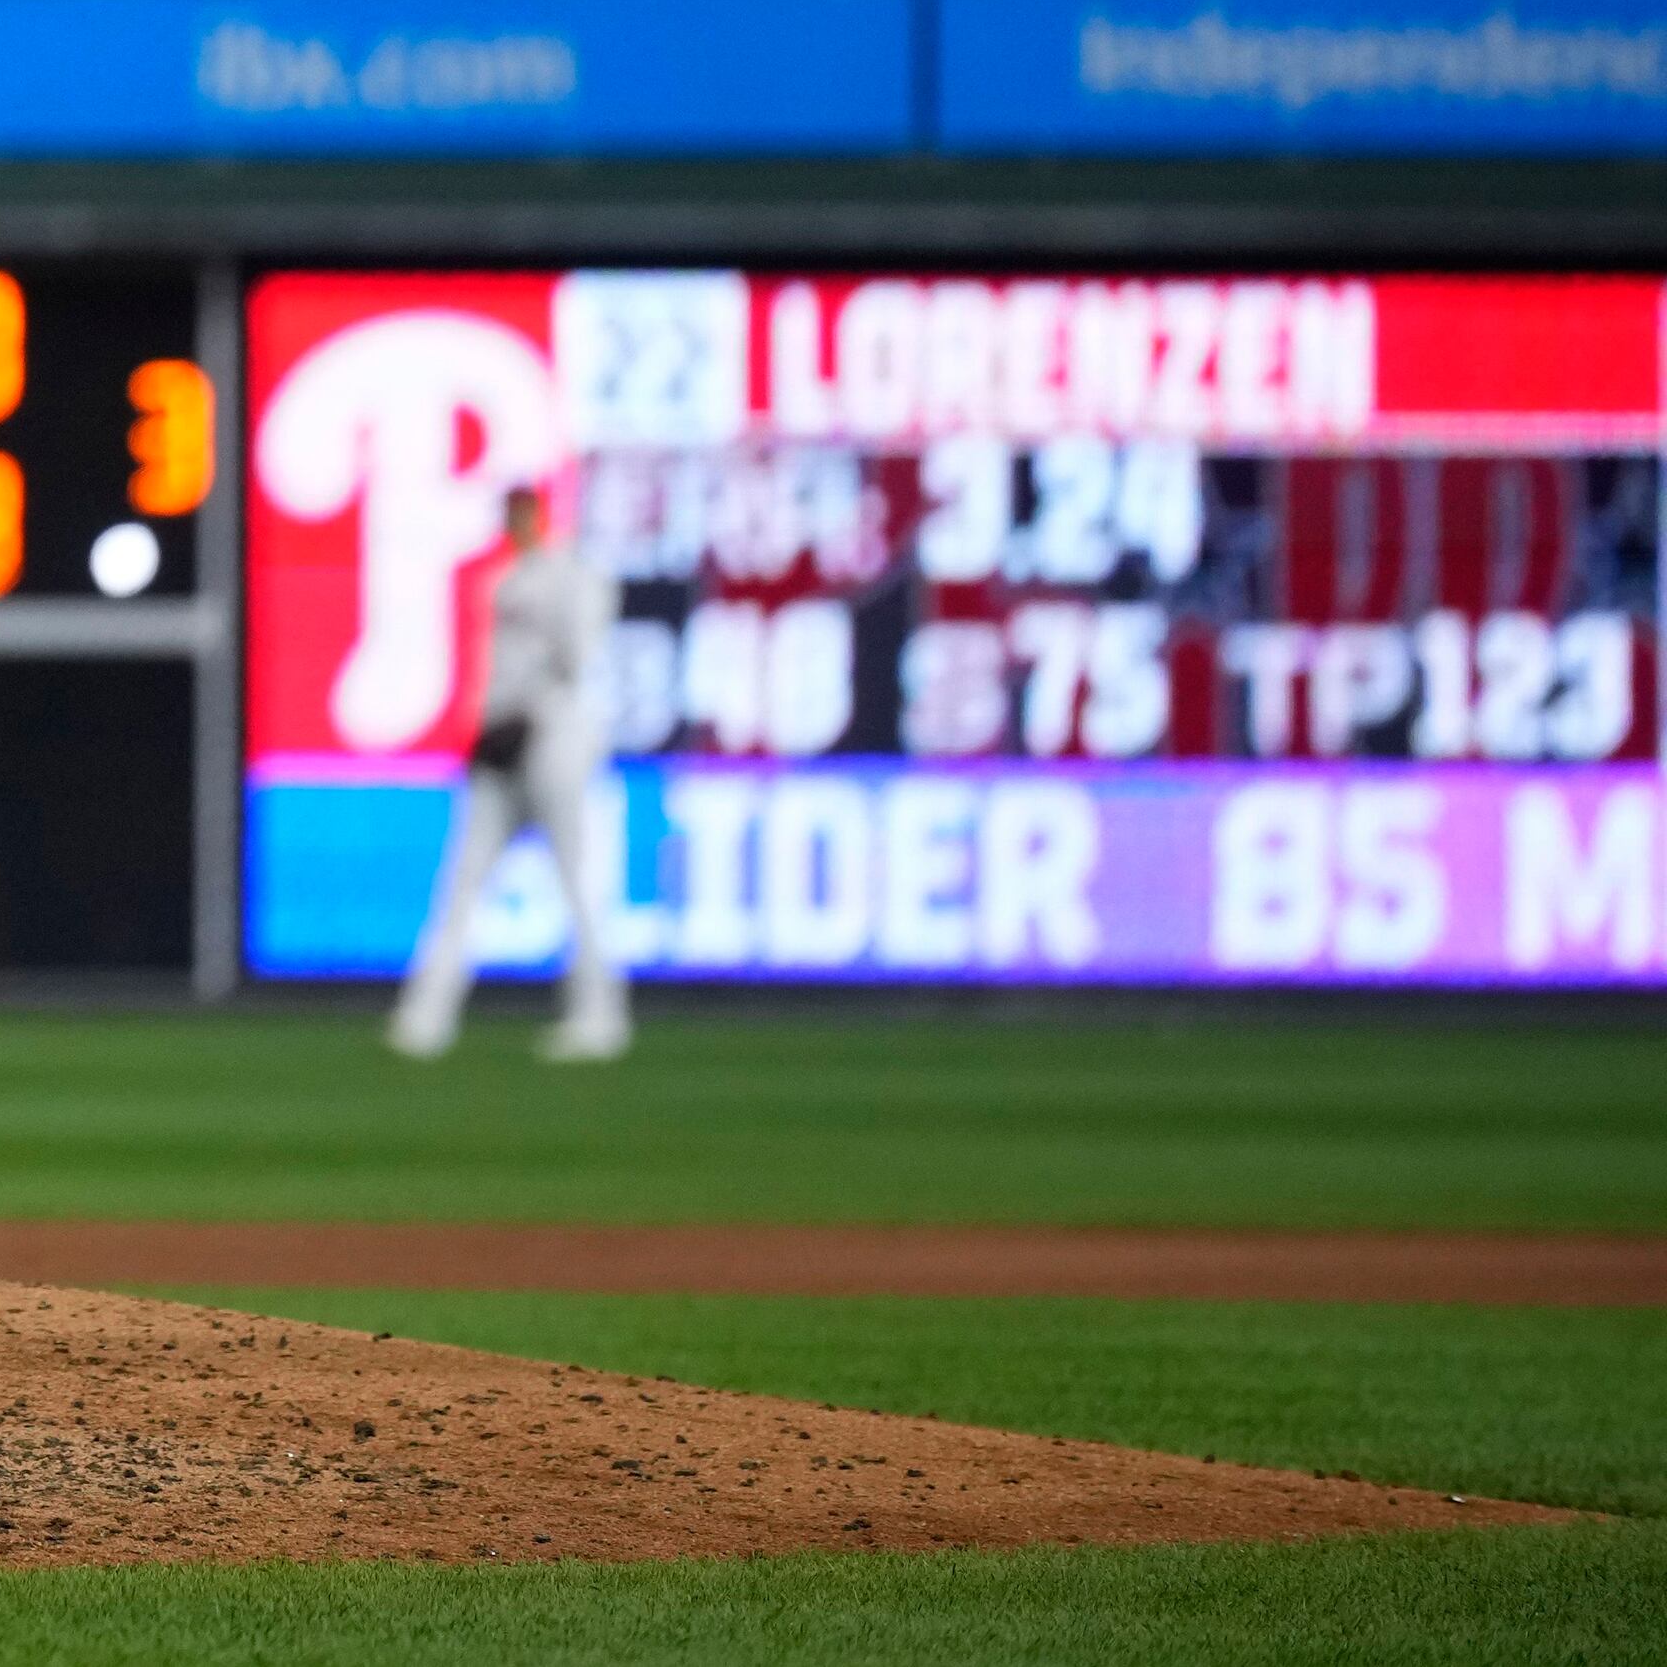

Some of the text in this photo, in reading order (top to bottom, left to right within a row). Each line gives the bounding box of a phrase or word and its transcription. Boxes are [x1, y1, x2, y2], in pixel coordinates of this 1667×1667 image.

[769, 278, 1375, 436] LORENZEN
[127, 358, 215, 517] 3
[917, 434, 1202, 582] 3.24
[1212, 779, 1445, 972] 85
